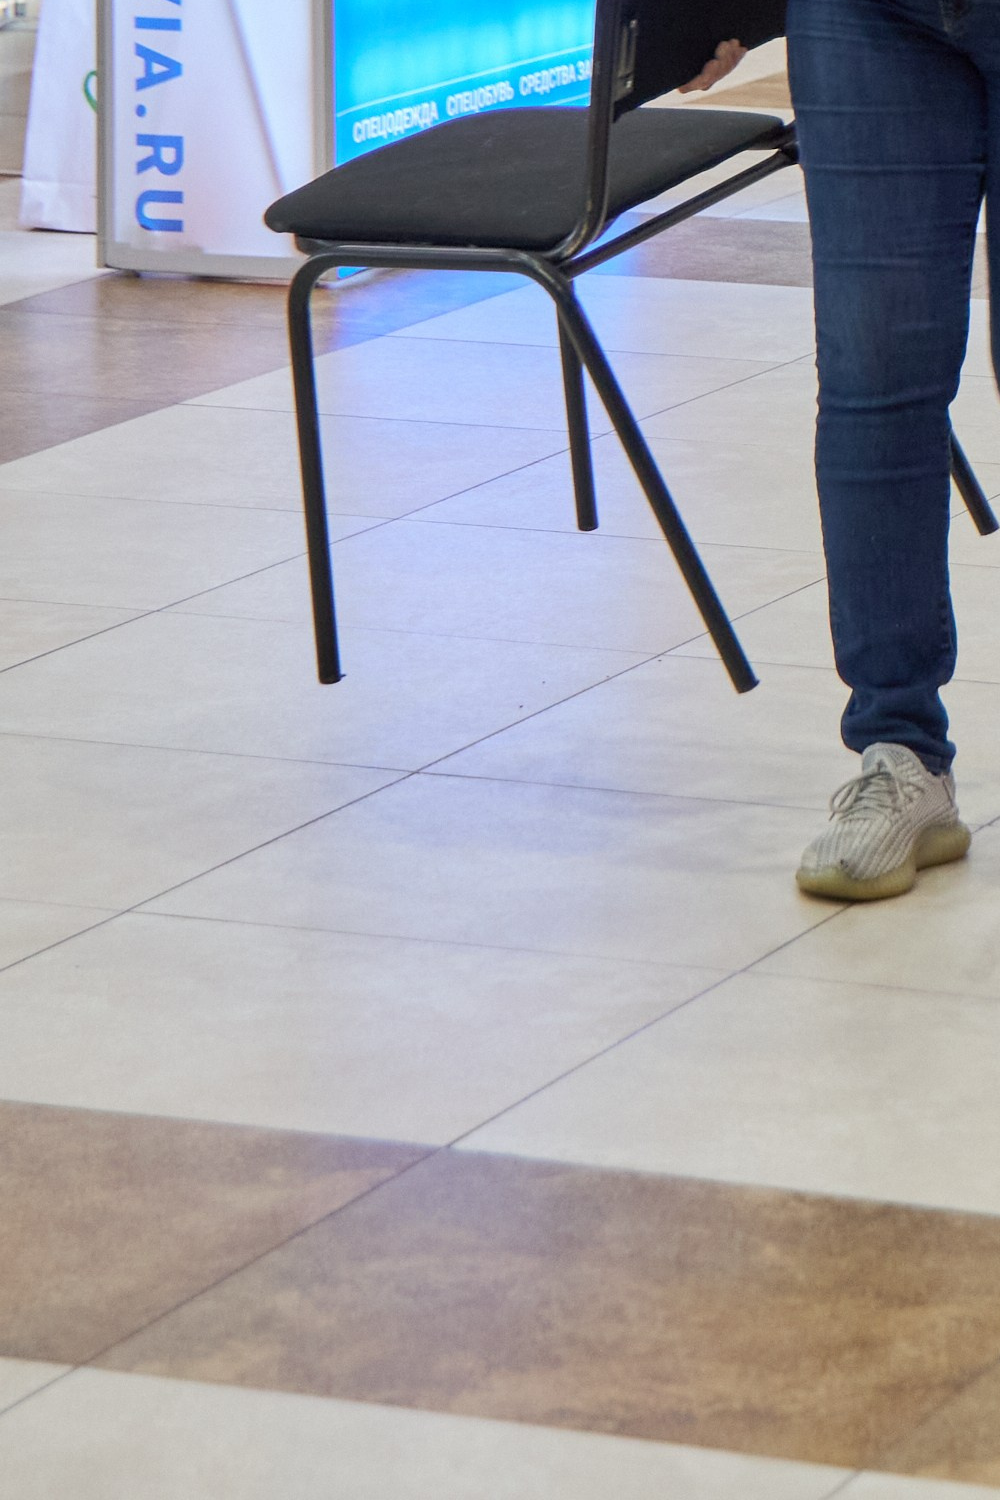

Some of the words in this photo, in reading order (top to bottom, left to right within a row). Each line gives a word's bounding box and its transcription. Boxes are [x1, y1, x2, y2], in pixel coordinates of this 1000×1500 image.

[352, 101, 440, 143] СПЕЦОДЕЖДА
[446, 80, 515, 116] СПЕЦОБУВЬ
[519, 64, 576, 97] СРЕДСТВА
